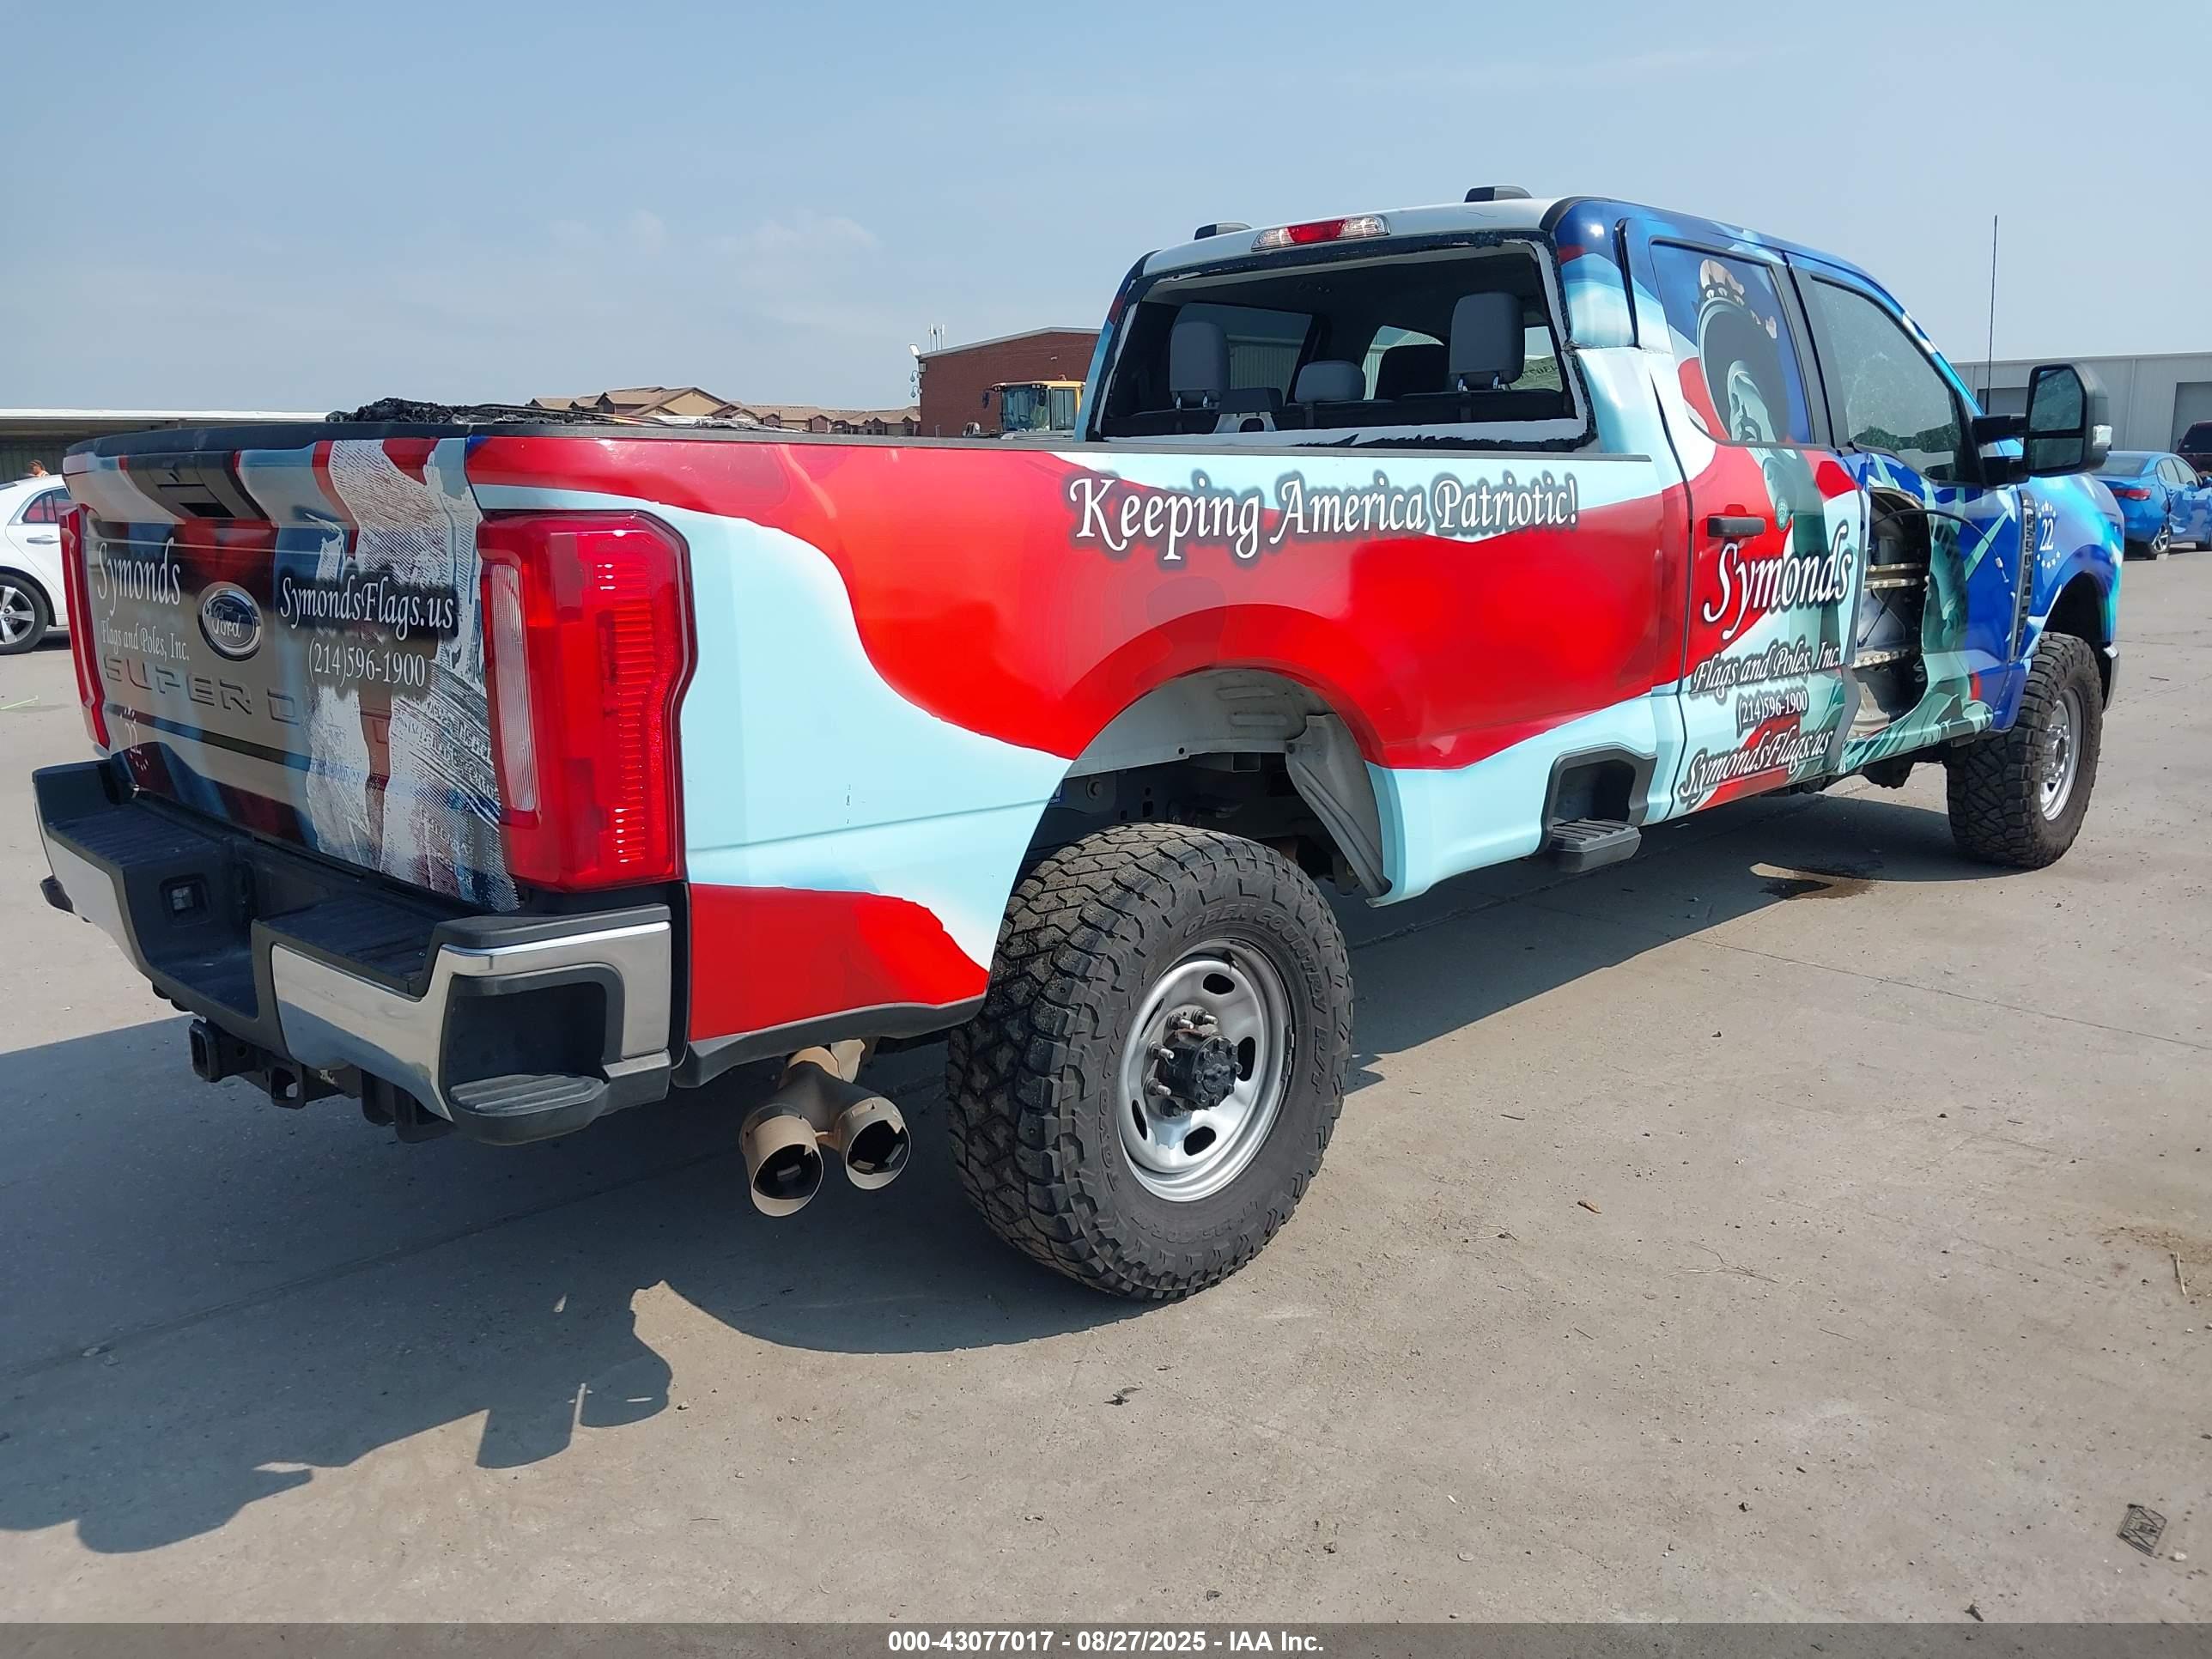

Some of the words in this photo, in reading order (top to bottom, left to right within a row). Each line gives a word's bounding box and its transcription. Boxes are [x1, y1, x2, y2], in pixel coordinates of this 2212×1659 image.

[1069, 477, 1260, 560] Keeping
[1269, 477, 1425, 544] America
[1432, 475, 1578, 530] Patriotic!
[2039, 518, 2054, 551] 22
[97, 537, 180, 617] Symonds
[1704, 524, 1852, 640] Symonds
[211, 601, 244, 639] Ford
[279, 574, 454, 641] SymondsFlags.us
[101, 617, 122, 654] Flags
[123, 623, 139, 650] and
[140, 625, 167, 661] Poles,
[170, 632, 190, 660] Inc.
[308, 637, 426, 688] (214)596-1900
[1693, 652, 1736, 696] Flags
[1740, 643, 1771, 684] and
[1772, 640, 1811, 678] Poles,
[1815, 643, 1840, 671] Inc.
[104, 654, 252, 715] SUPER
[1737, 690, 1808, 731] (214)596-1900
[125, 721, 143, 756] 22
[1680, 726, 1834, 802] SymondsFlags.us
[1184, 902, 1255, 938] OPEN
[1254, 908, 1328, 1015] COUNTRY
